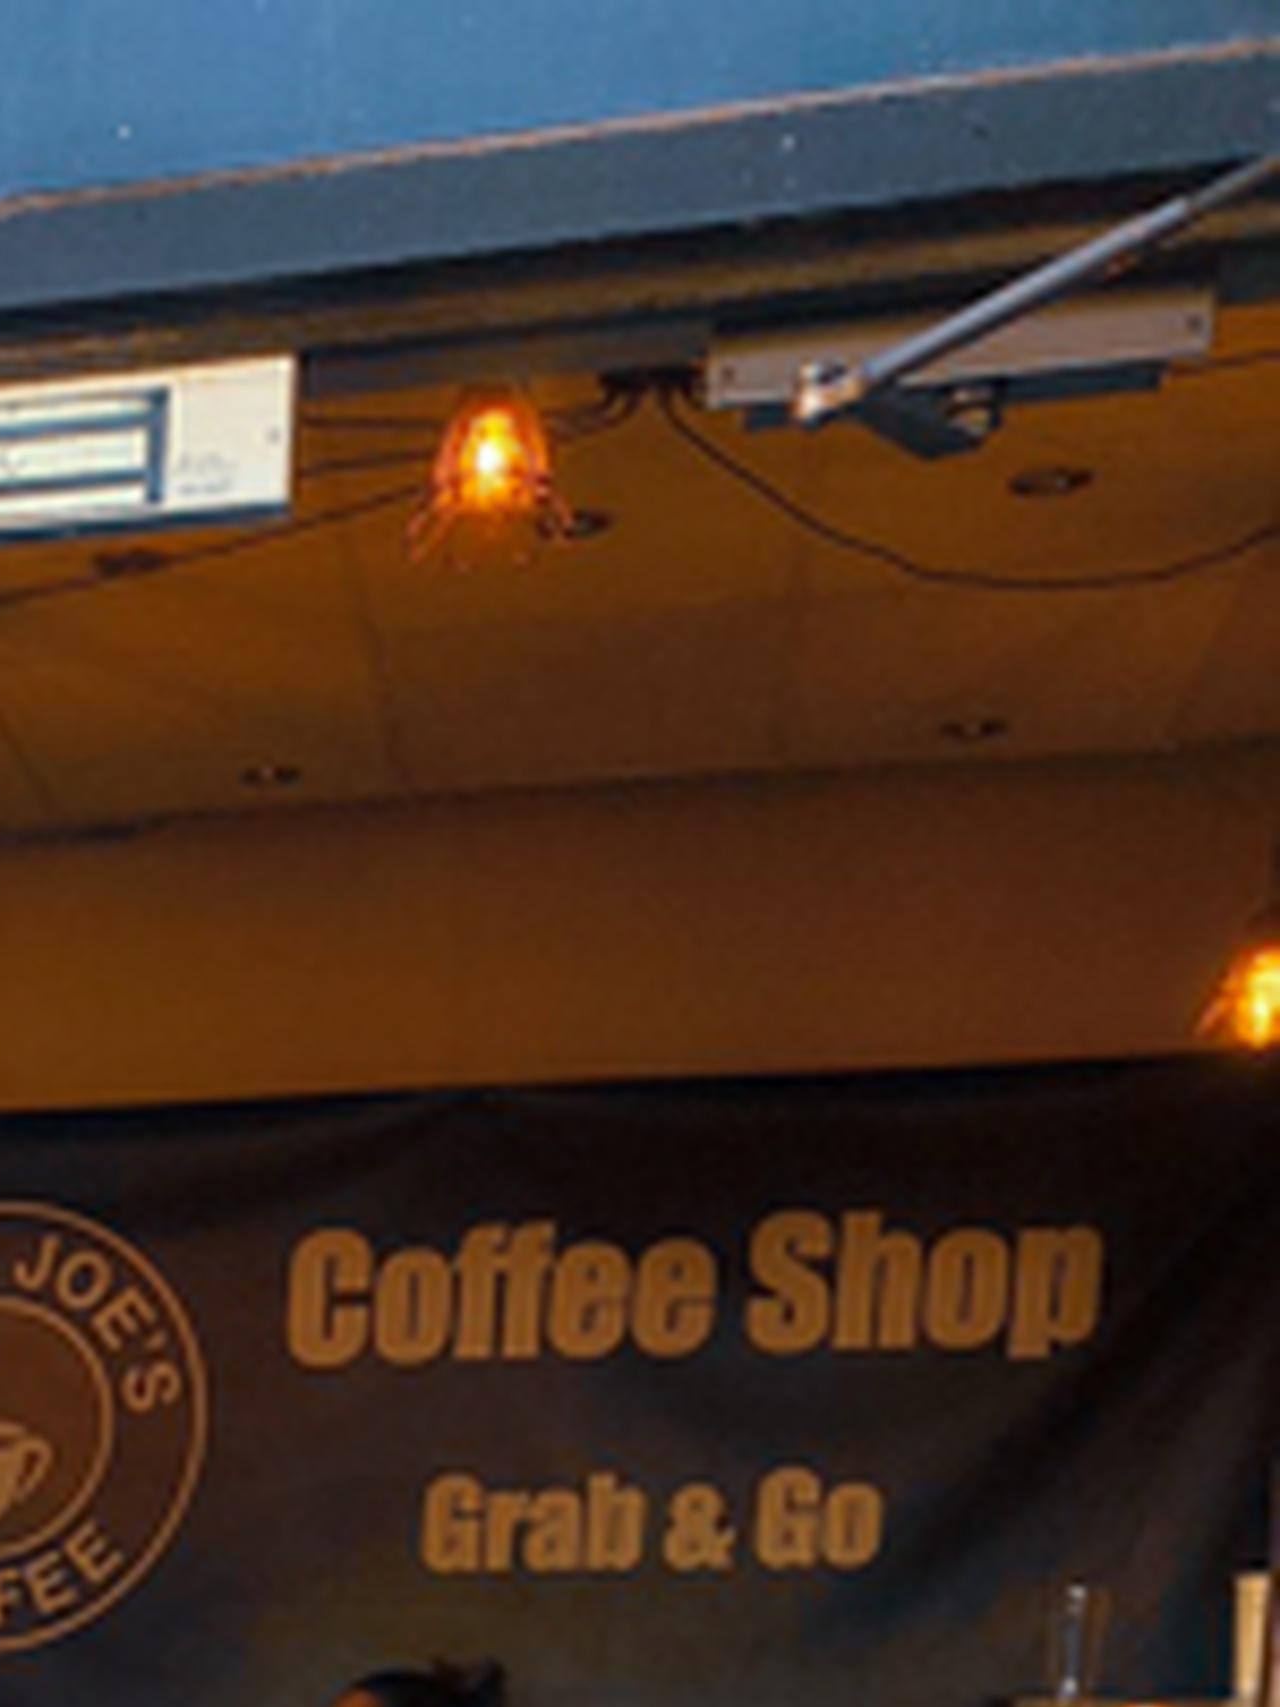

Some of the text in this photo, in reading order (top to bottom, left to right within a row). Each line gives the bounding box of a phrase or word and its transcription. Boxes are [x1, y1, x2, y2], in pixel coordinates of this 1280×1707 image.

[12, 1232, 181, 1414] JOE'S
[287, 1210, 1104, 1368] Coffee Shop
[422, 1468, 883, 1572] Grab & Go
